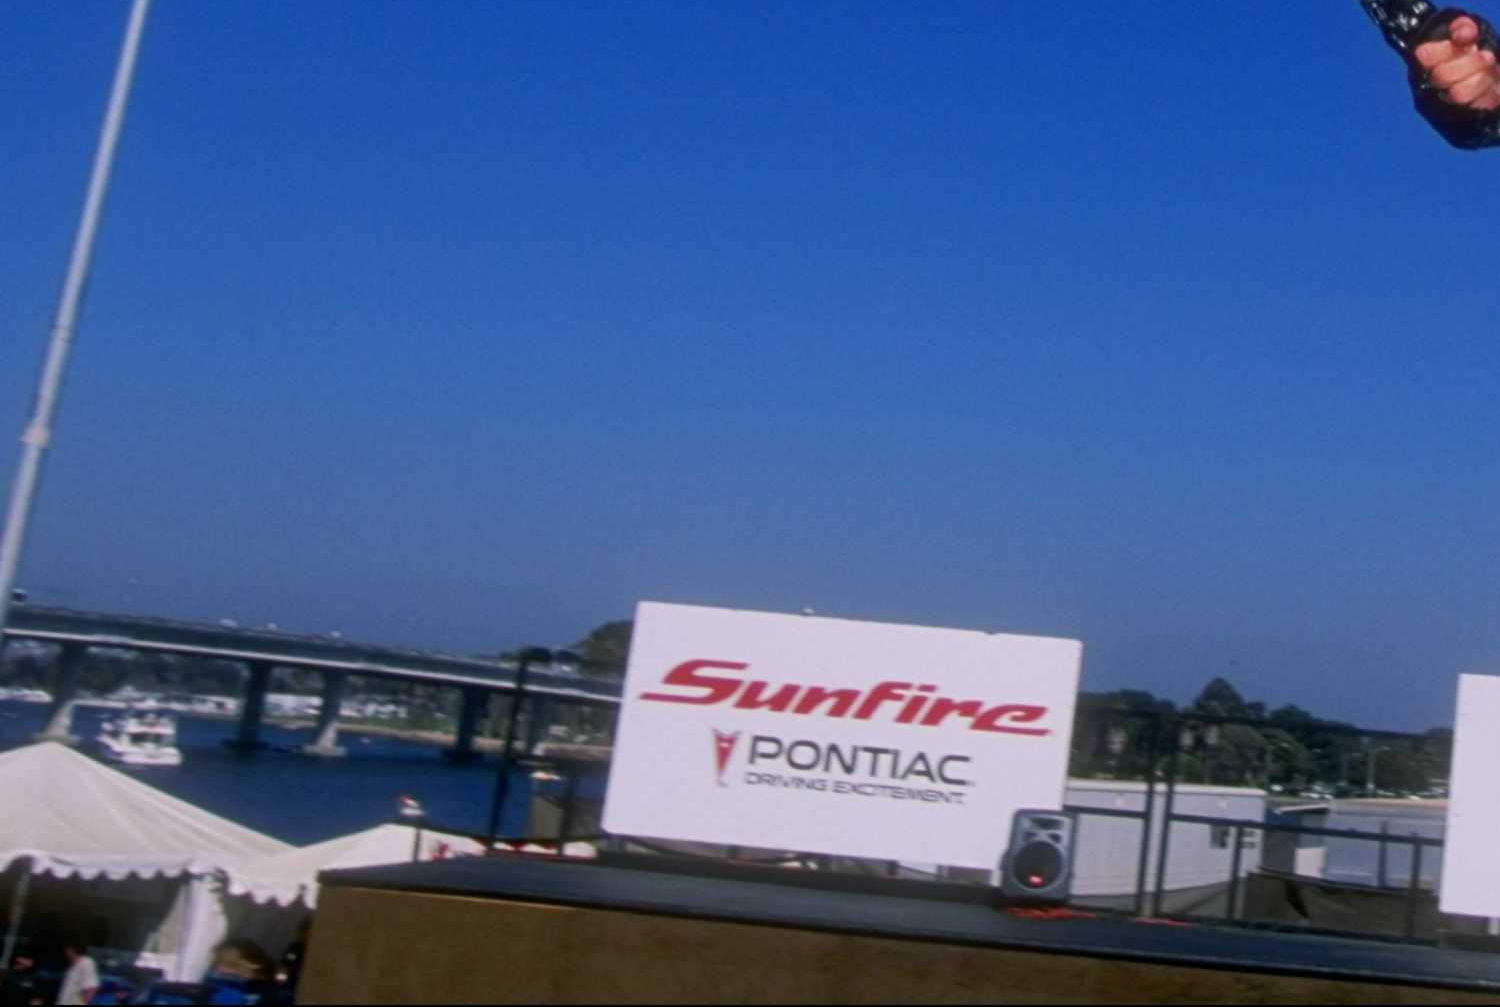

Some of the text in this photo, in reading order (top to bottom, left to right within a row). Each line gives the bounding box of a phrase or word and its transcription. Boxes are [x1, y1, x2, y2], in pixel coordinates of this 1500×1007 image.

[639, 658, 1053, 737] Sunfire
[746, 736, 973, 786] PONTIAC
[744, 771, 967, 805] DRIVING EXCITEMENT
